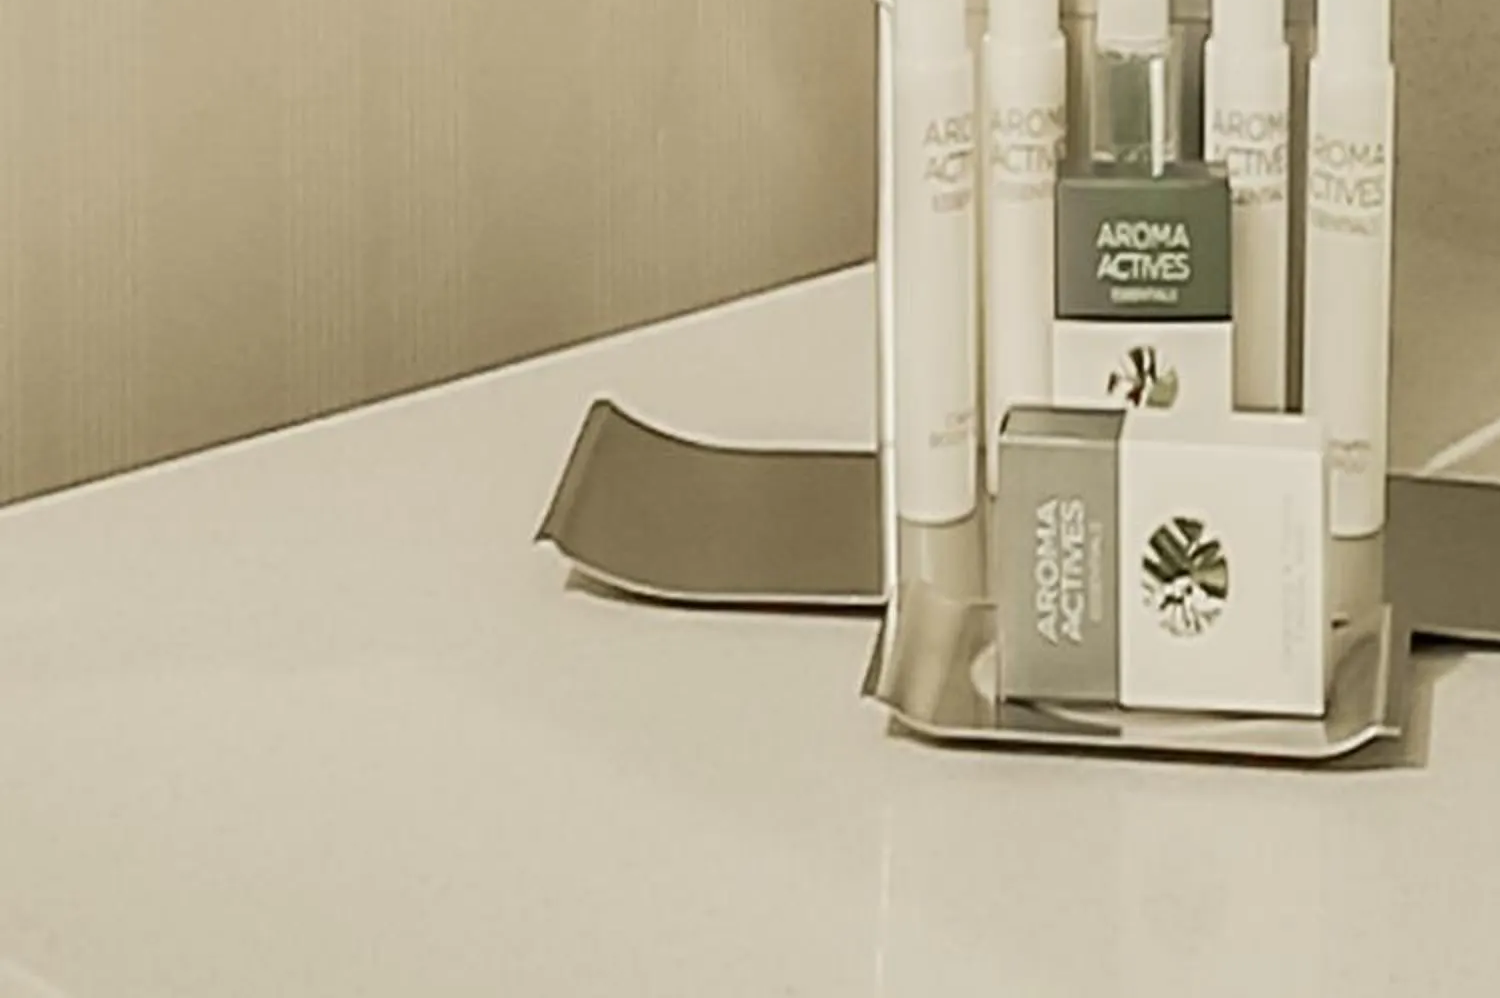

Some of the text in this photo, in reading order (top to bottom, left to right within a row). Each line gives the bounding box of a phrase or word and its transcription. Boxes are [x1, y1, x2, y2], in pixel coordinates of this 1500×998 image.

[1096, 220, 1190, 250] AROMA
[1096, 252, 1191, 281] ACTIVES
[1035, 499, 1059, 644] AROMA
[1060, 499, 1085, 643] ACTIVES
